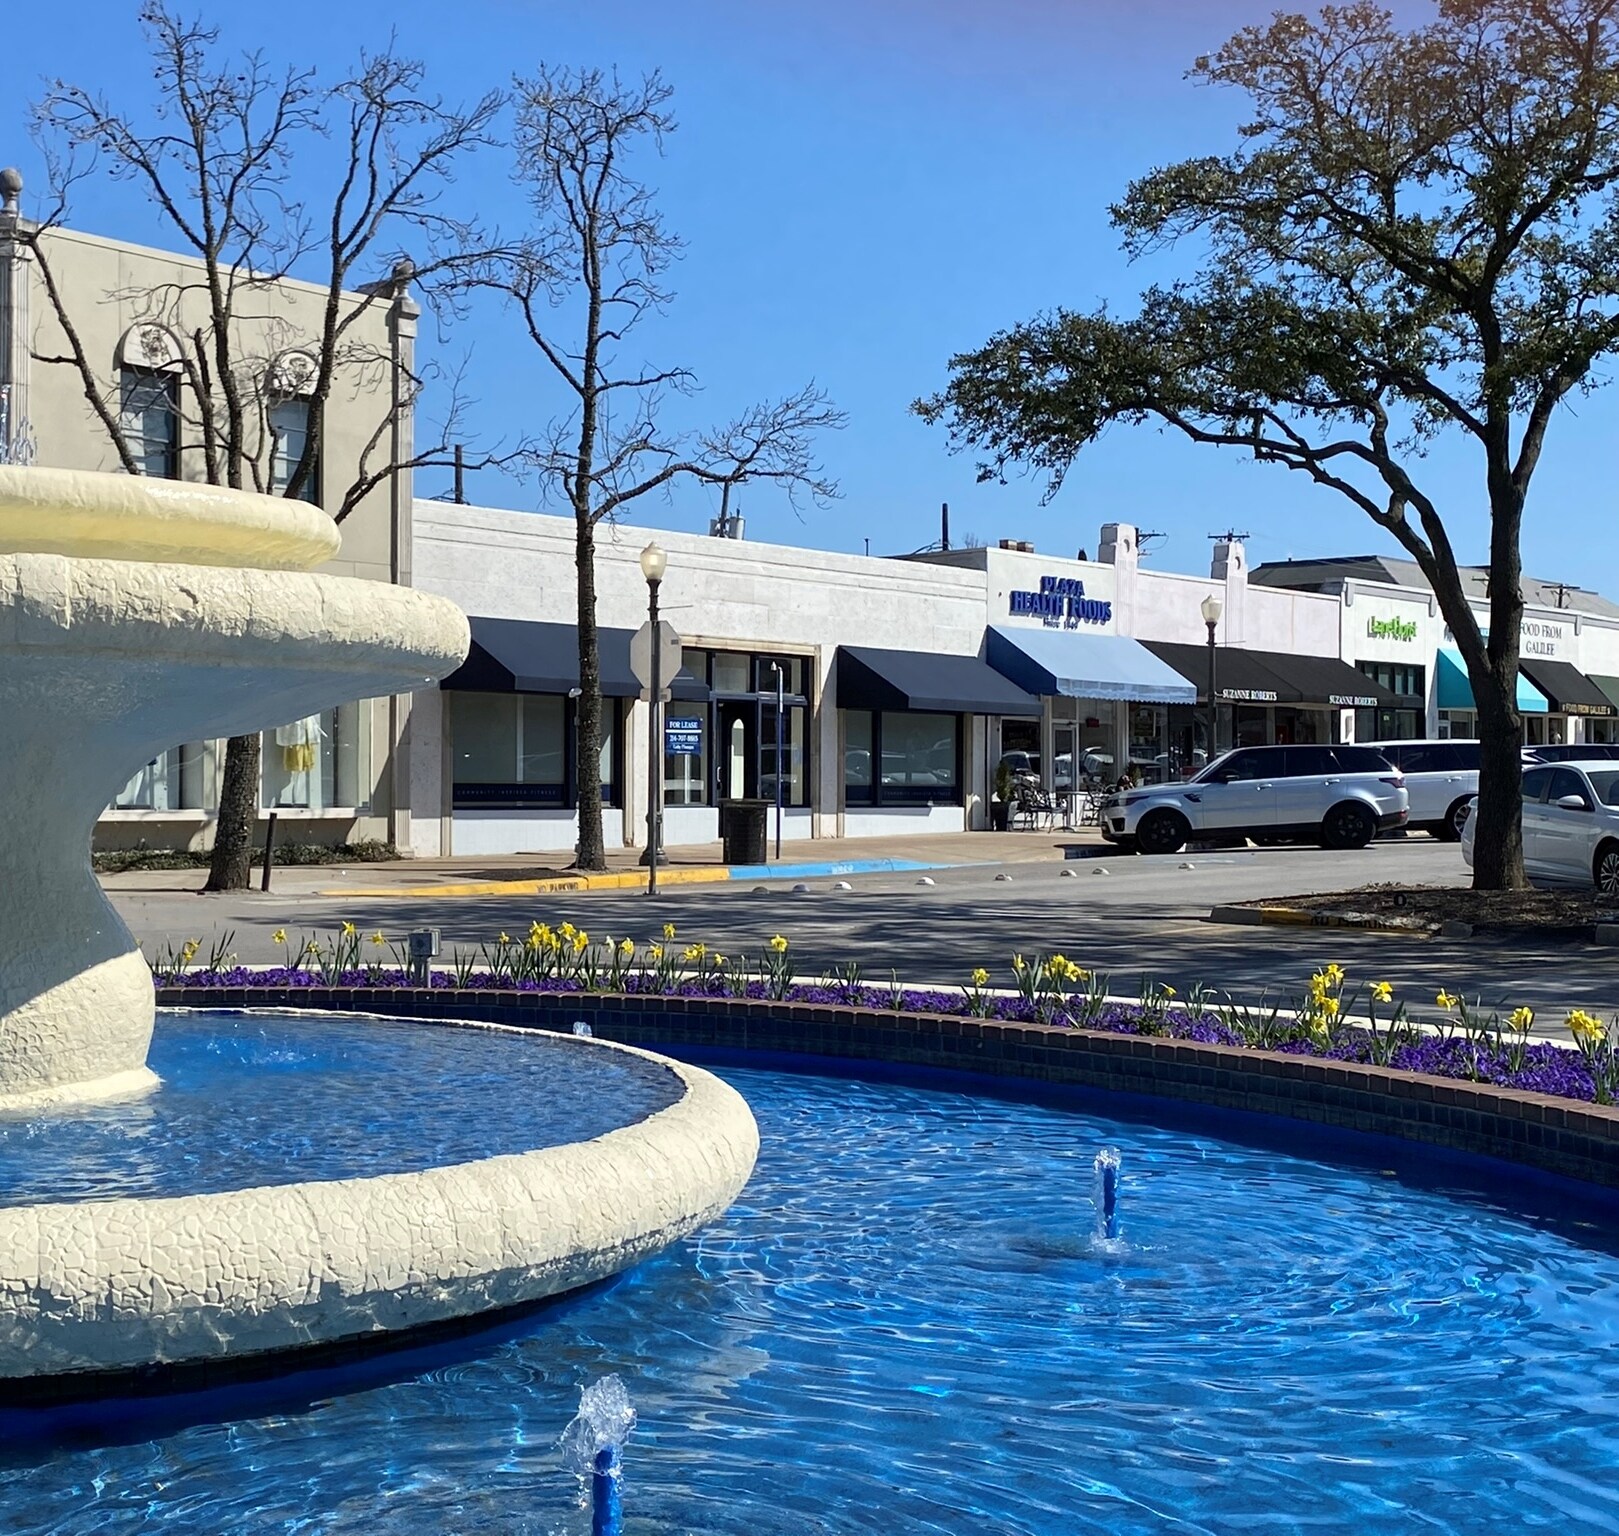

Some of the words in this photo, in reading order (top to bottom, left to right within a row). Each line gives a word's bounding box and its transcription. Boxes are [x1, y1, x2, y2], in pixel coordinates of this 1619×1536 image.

[1040, 576, 1085, 596] PLAZA
[1009, 591, 1064, 616] HEALTH
[1067, 597, 1112, 622] FOODS
[1542, 625, 1562, 639] FROM
[1526, 641, 1555, 656] GALILEE
[1222, 689, 1249, 700] SUZANNE
[1251, 690, 1277, 701] ROBERTS
[1329, 695, 1353, 705] SUZANNE
[1354, 696, 1377, 706] ROBERTS
[1566, 703, 1577, 712] FOOD
